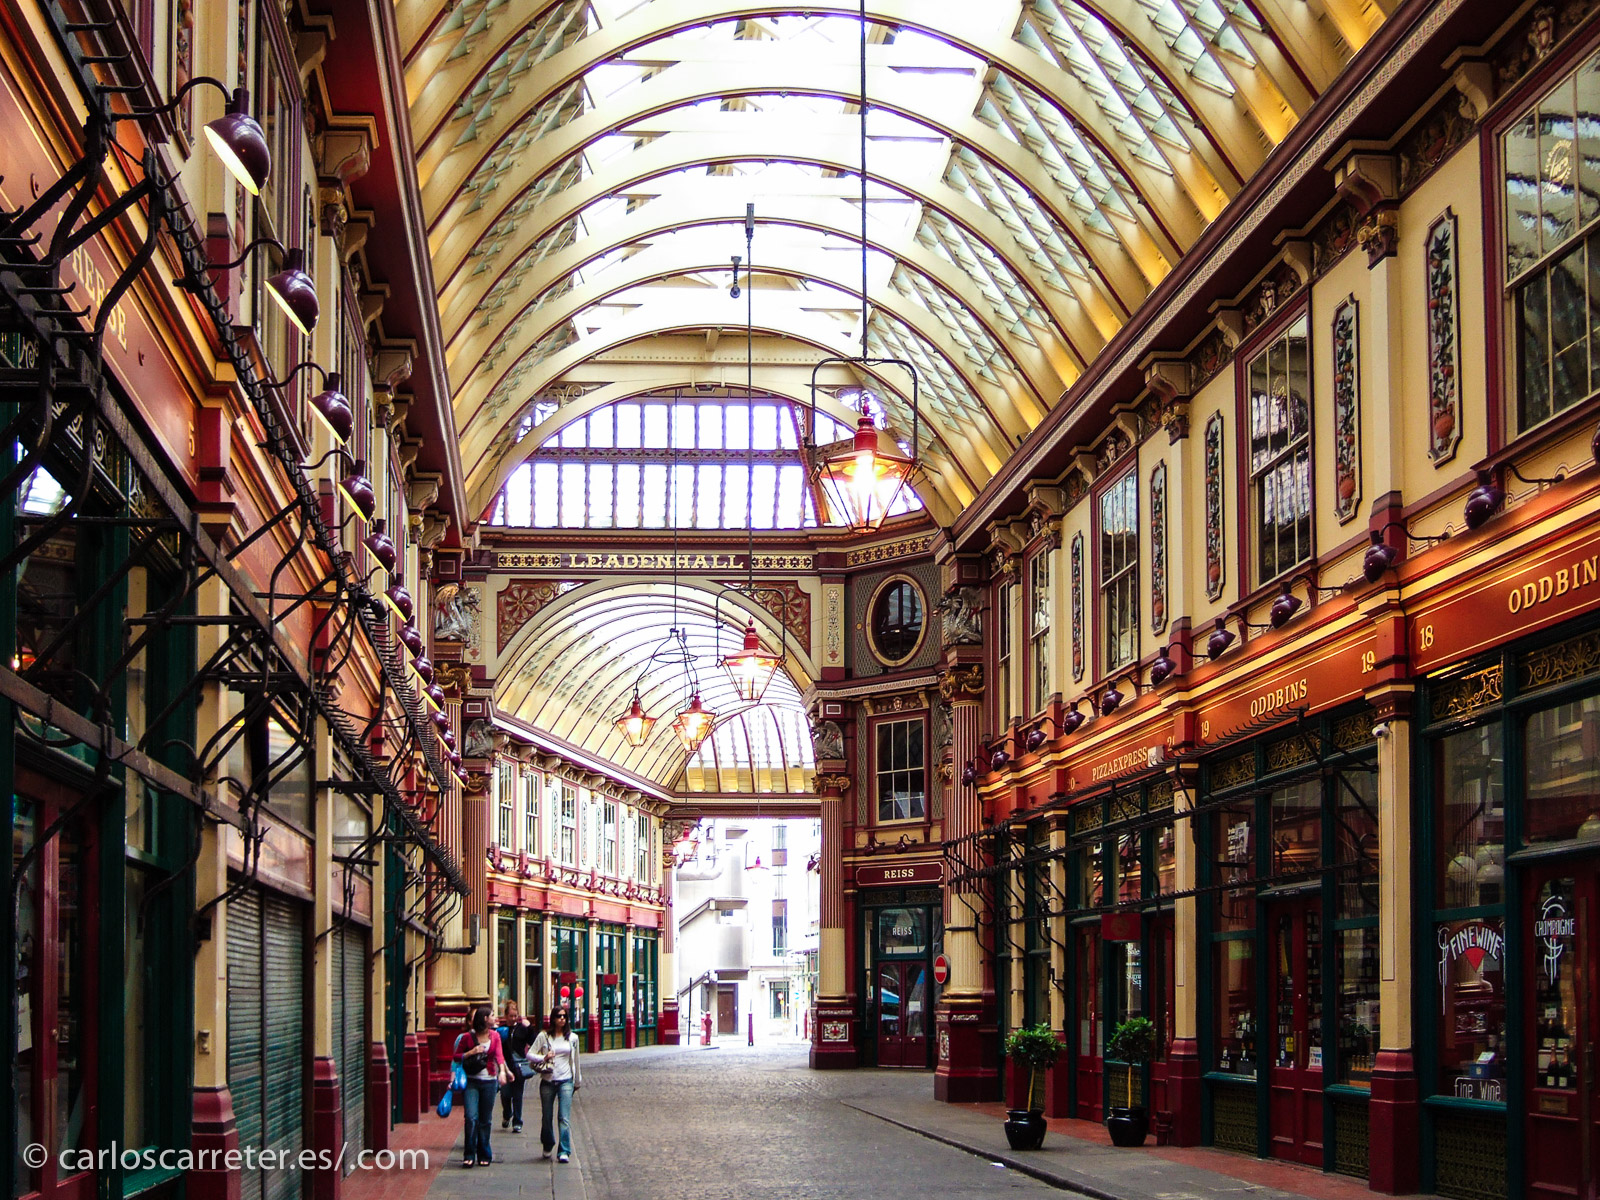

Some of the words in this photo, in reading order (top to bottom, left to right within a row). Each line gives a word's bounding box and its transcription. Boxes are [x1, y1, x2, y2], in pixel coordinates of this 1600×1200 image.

[188, 421, 195, 457] 5
[569, 554, 743, 569] LEADENHALL
[1508, 555, 1599, 614] ODDBIN
[1420, 624, 1435, 651] 18
[1361, 650, 1377, 674] 19
[1250, 678, 1308, 719] ODDBINS
[1200, 720, 1211, 740] 19
[1091, 746, 1148, 782] PIZZAEXPRESS
[883, 868, 915, 880] REISS
[892, 926, 913, 937] REISS
